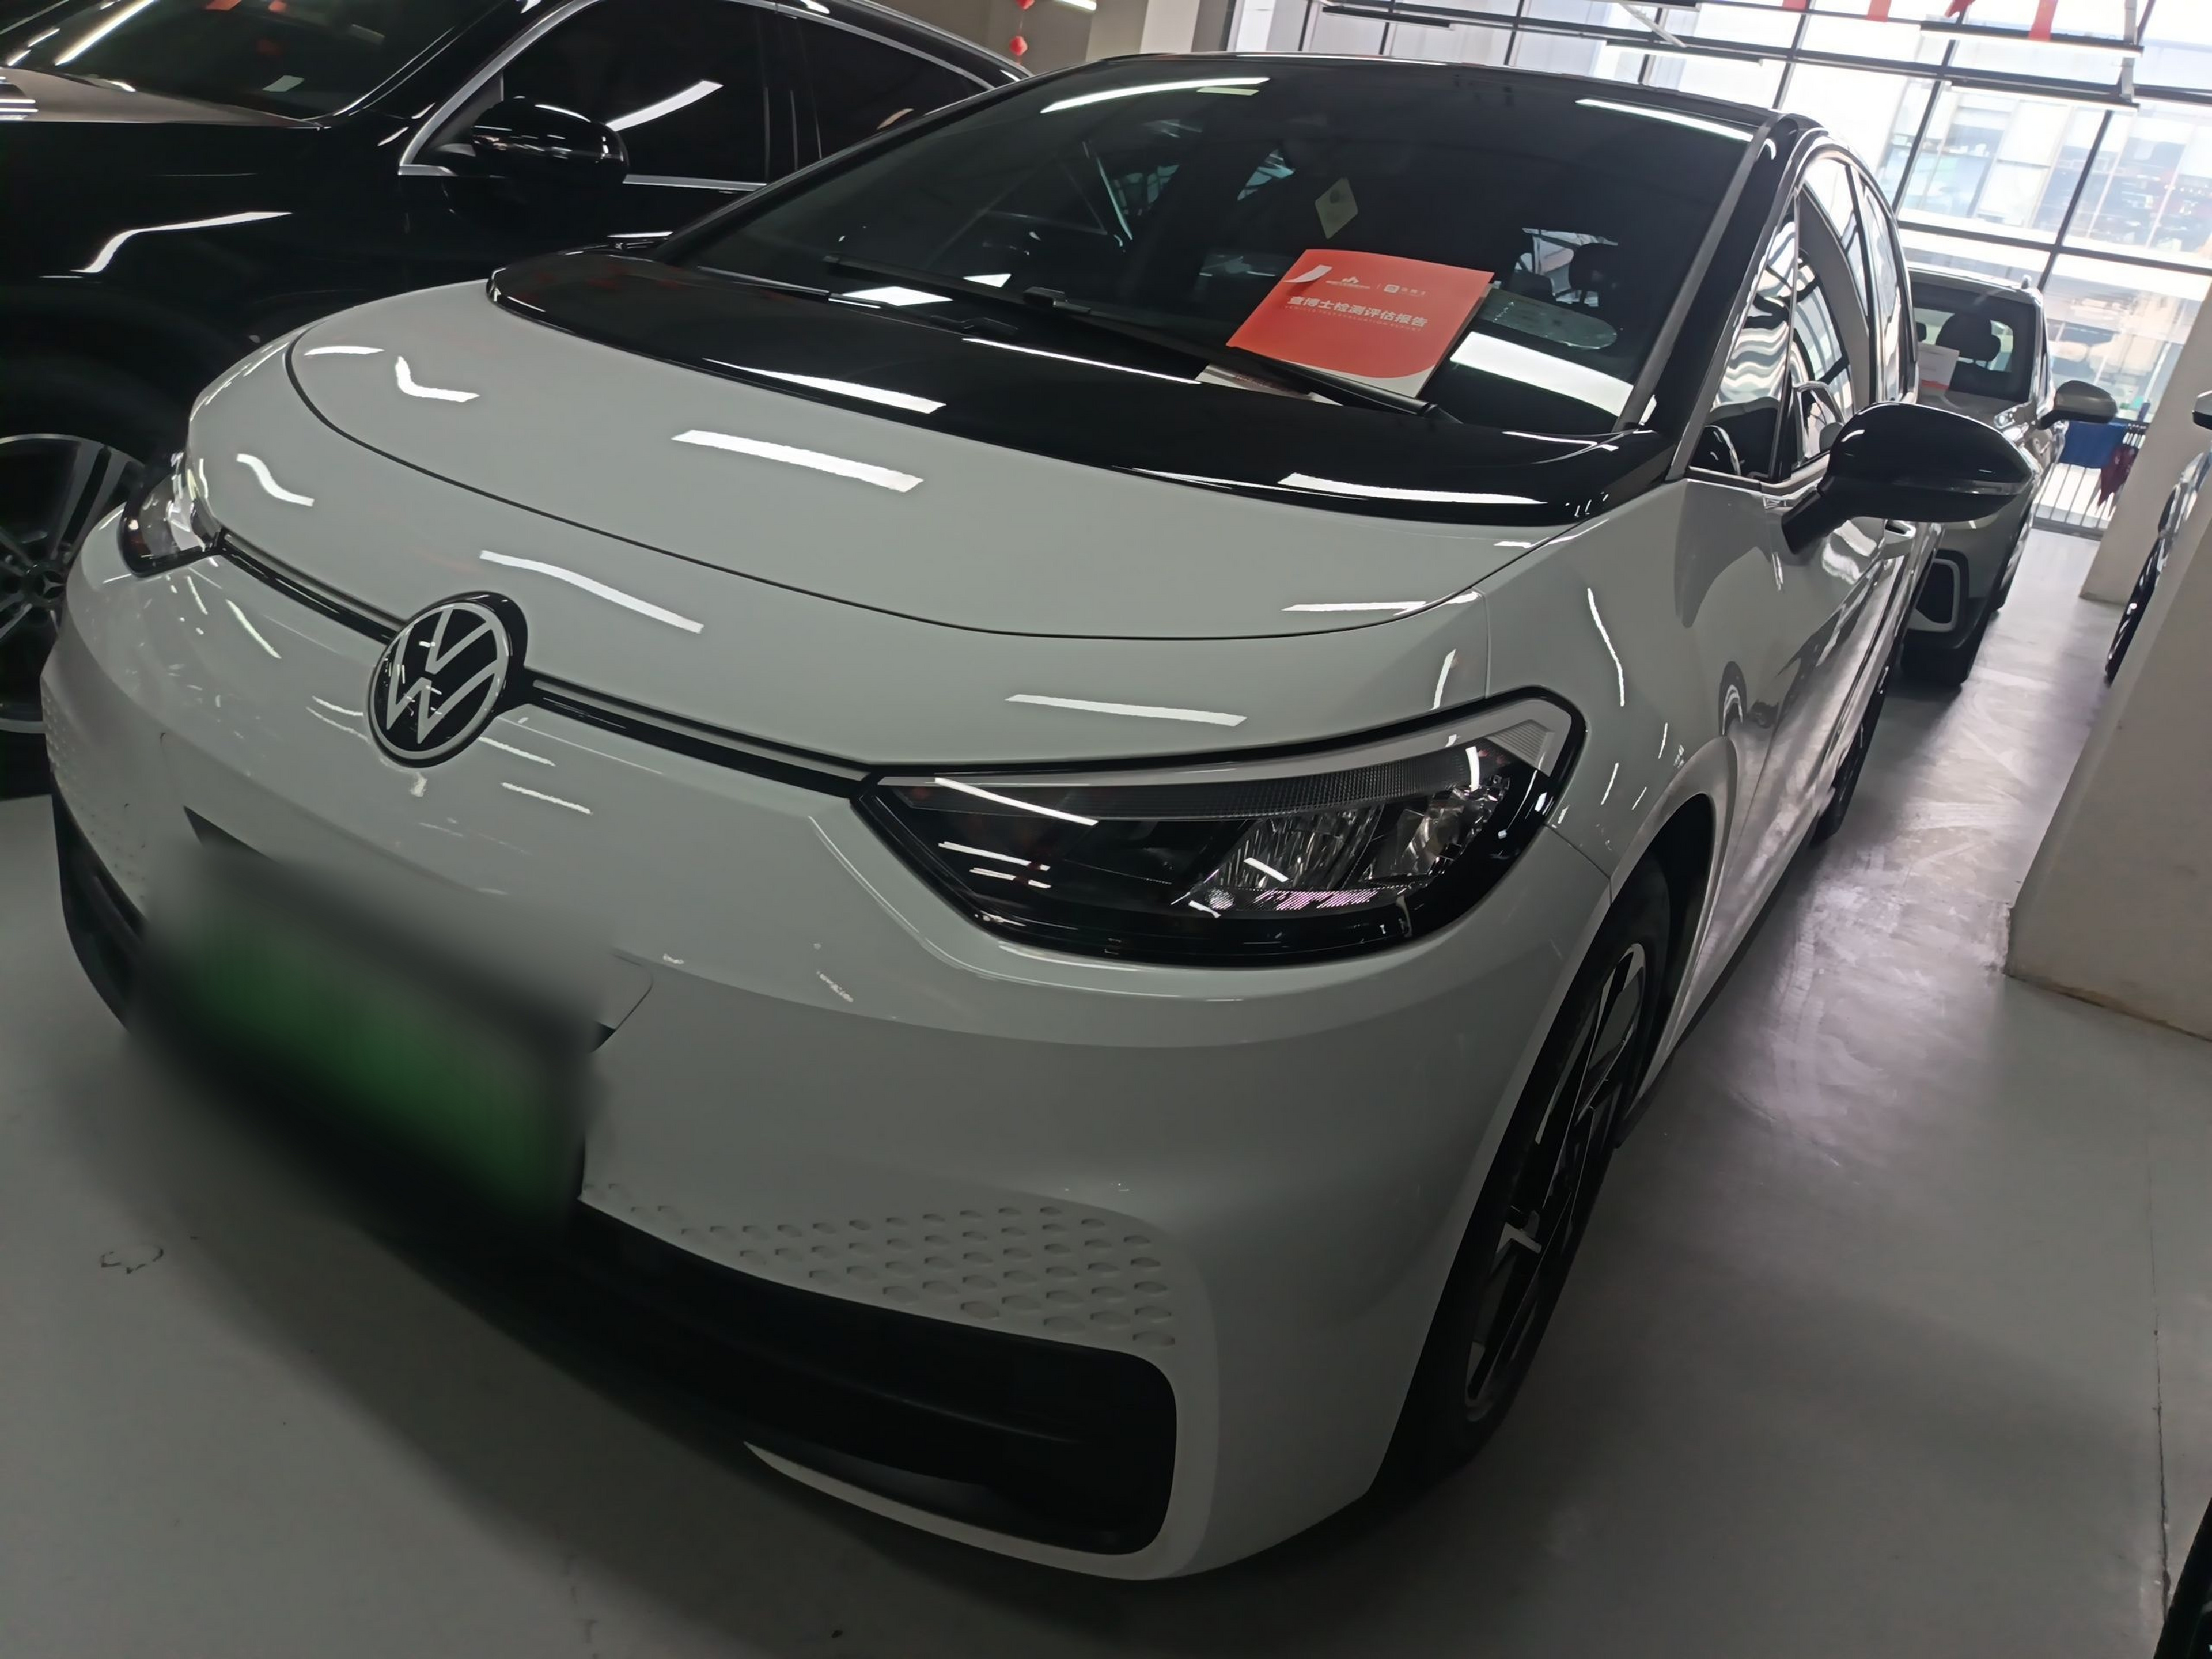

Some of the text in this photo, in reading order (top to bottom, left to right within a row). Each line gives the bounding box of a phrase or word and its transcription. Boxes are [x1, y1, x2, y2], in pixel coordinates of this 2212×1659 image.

[1287, 296, 1427, 327] 查博士检测评估报告
